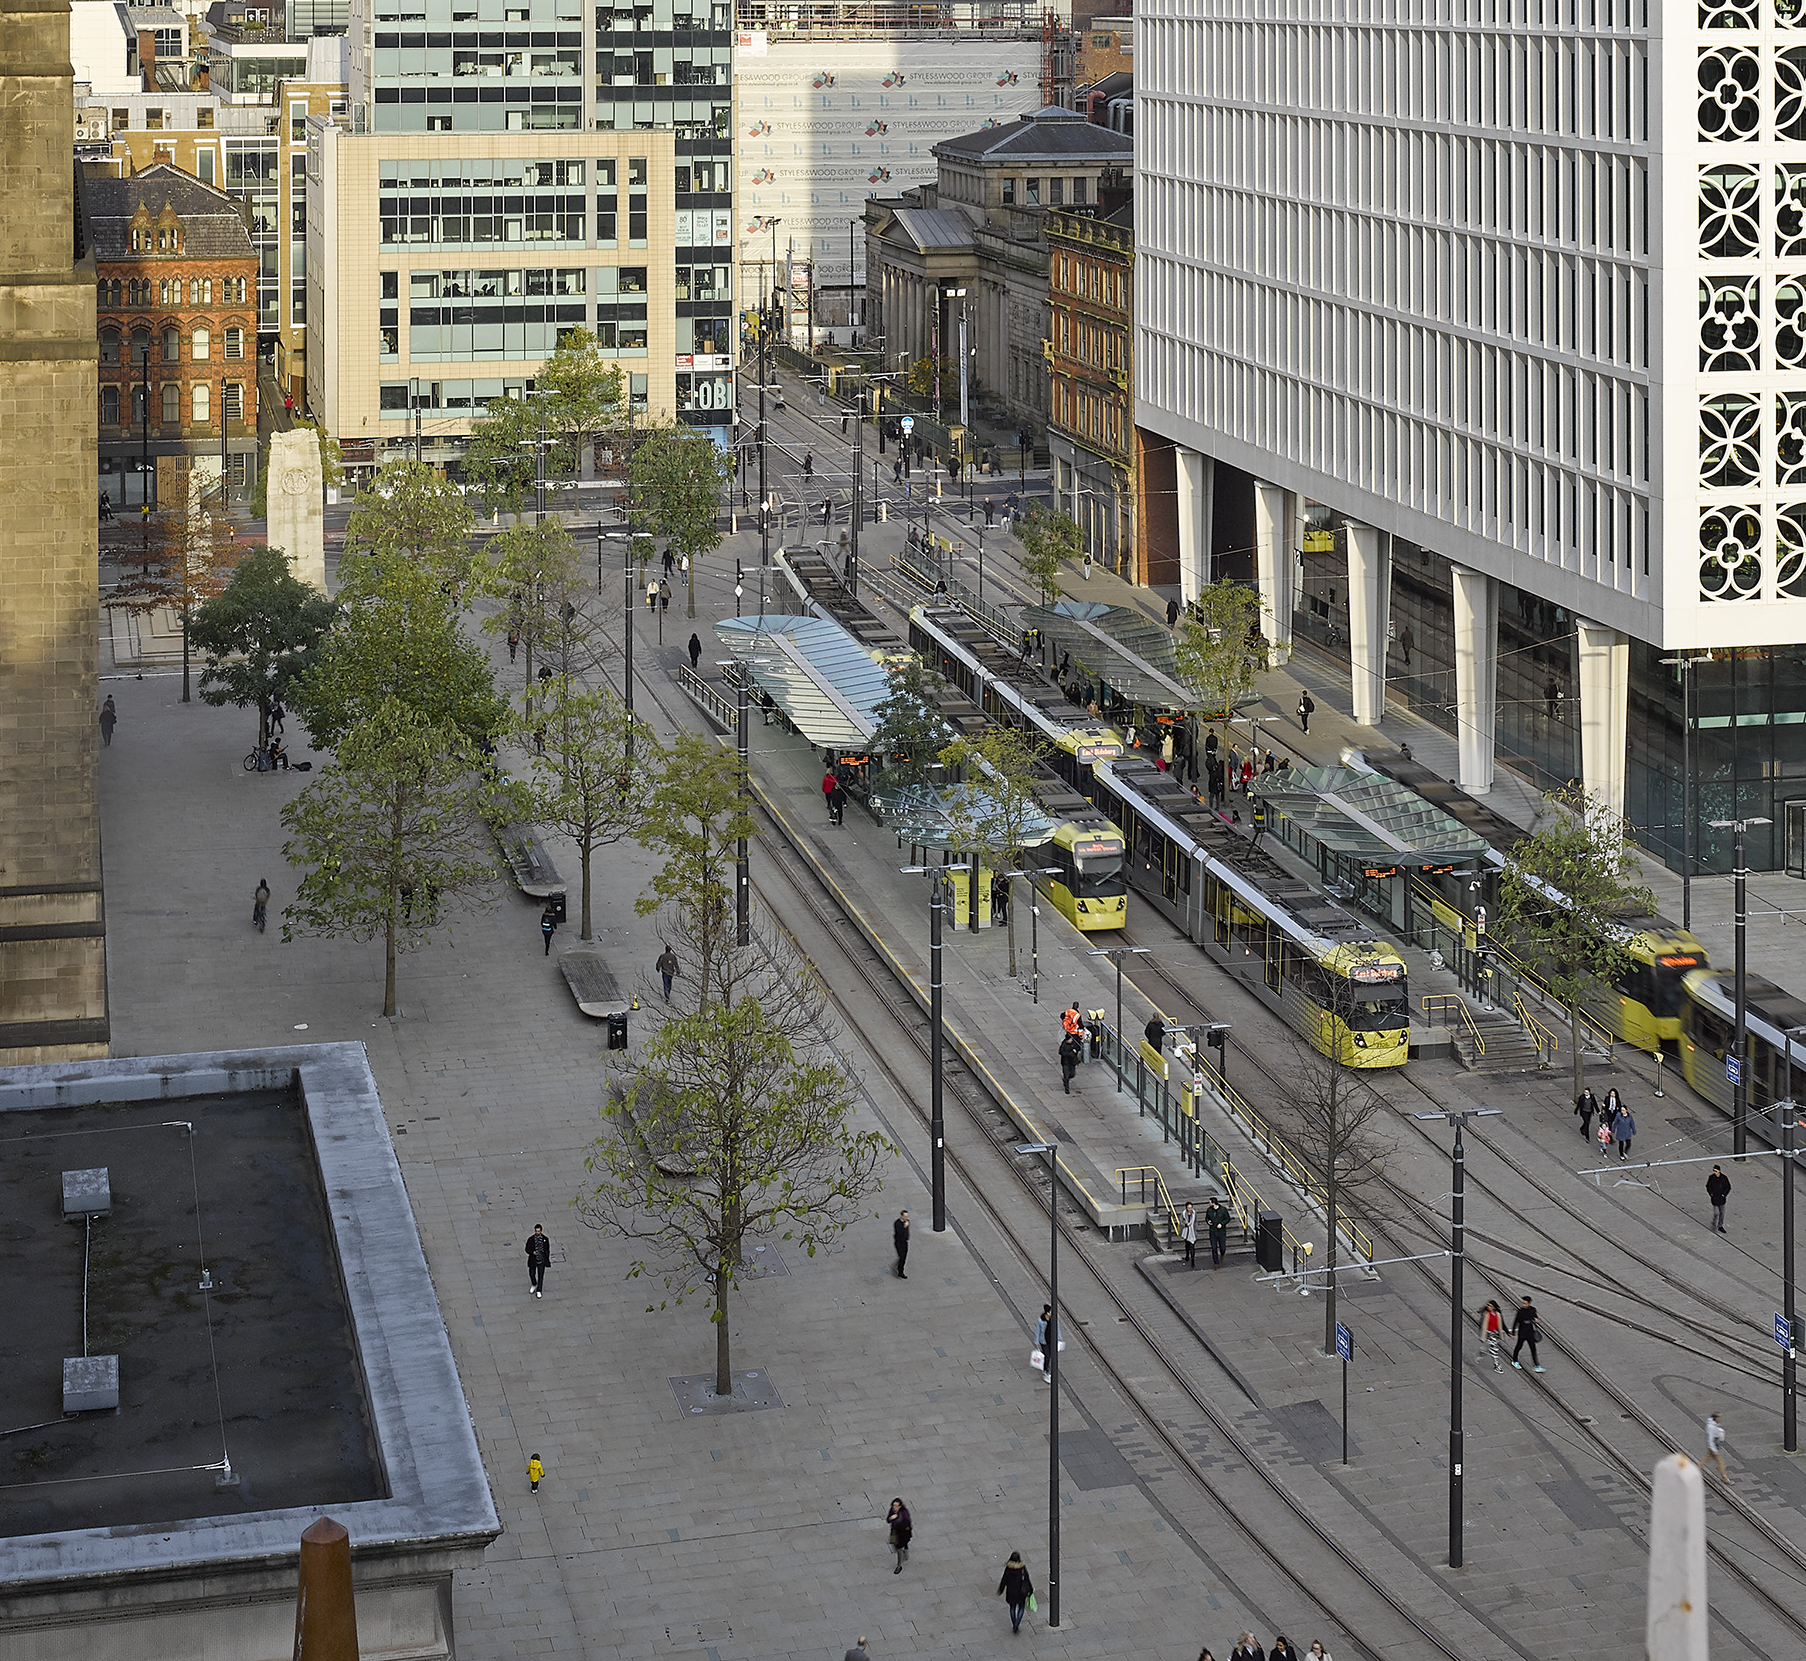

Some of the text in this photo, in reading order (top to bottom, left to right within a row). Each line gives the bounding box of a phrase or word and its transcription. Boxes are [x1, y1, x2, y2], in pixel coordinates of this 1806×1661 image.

[782, 73, 810, 81] GROUP
[909, 71, 993, 80] STYLES&WOOD GROUP
[776, 121, 862, 130] STYLES&WOOD GROUP
[892, 120, 976, 129] STYLES&WOOD GROUP
[779, 168, 865, 177] STYLES&WOOD GROUP
[781, 218, 831, 226] YLES&WOOD
